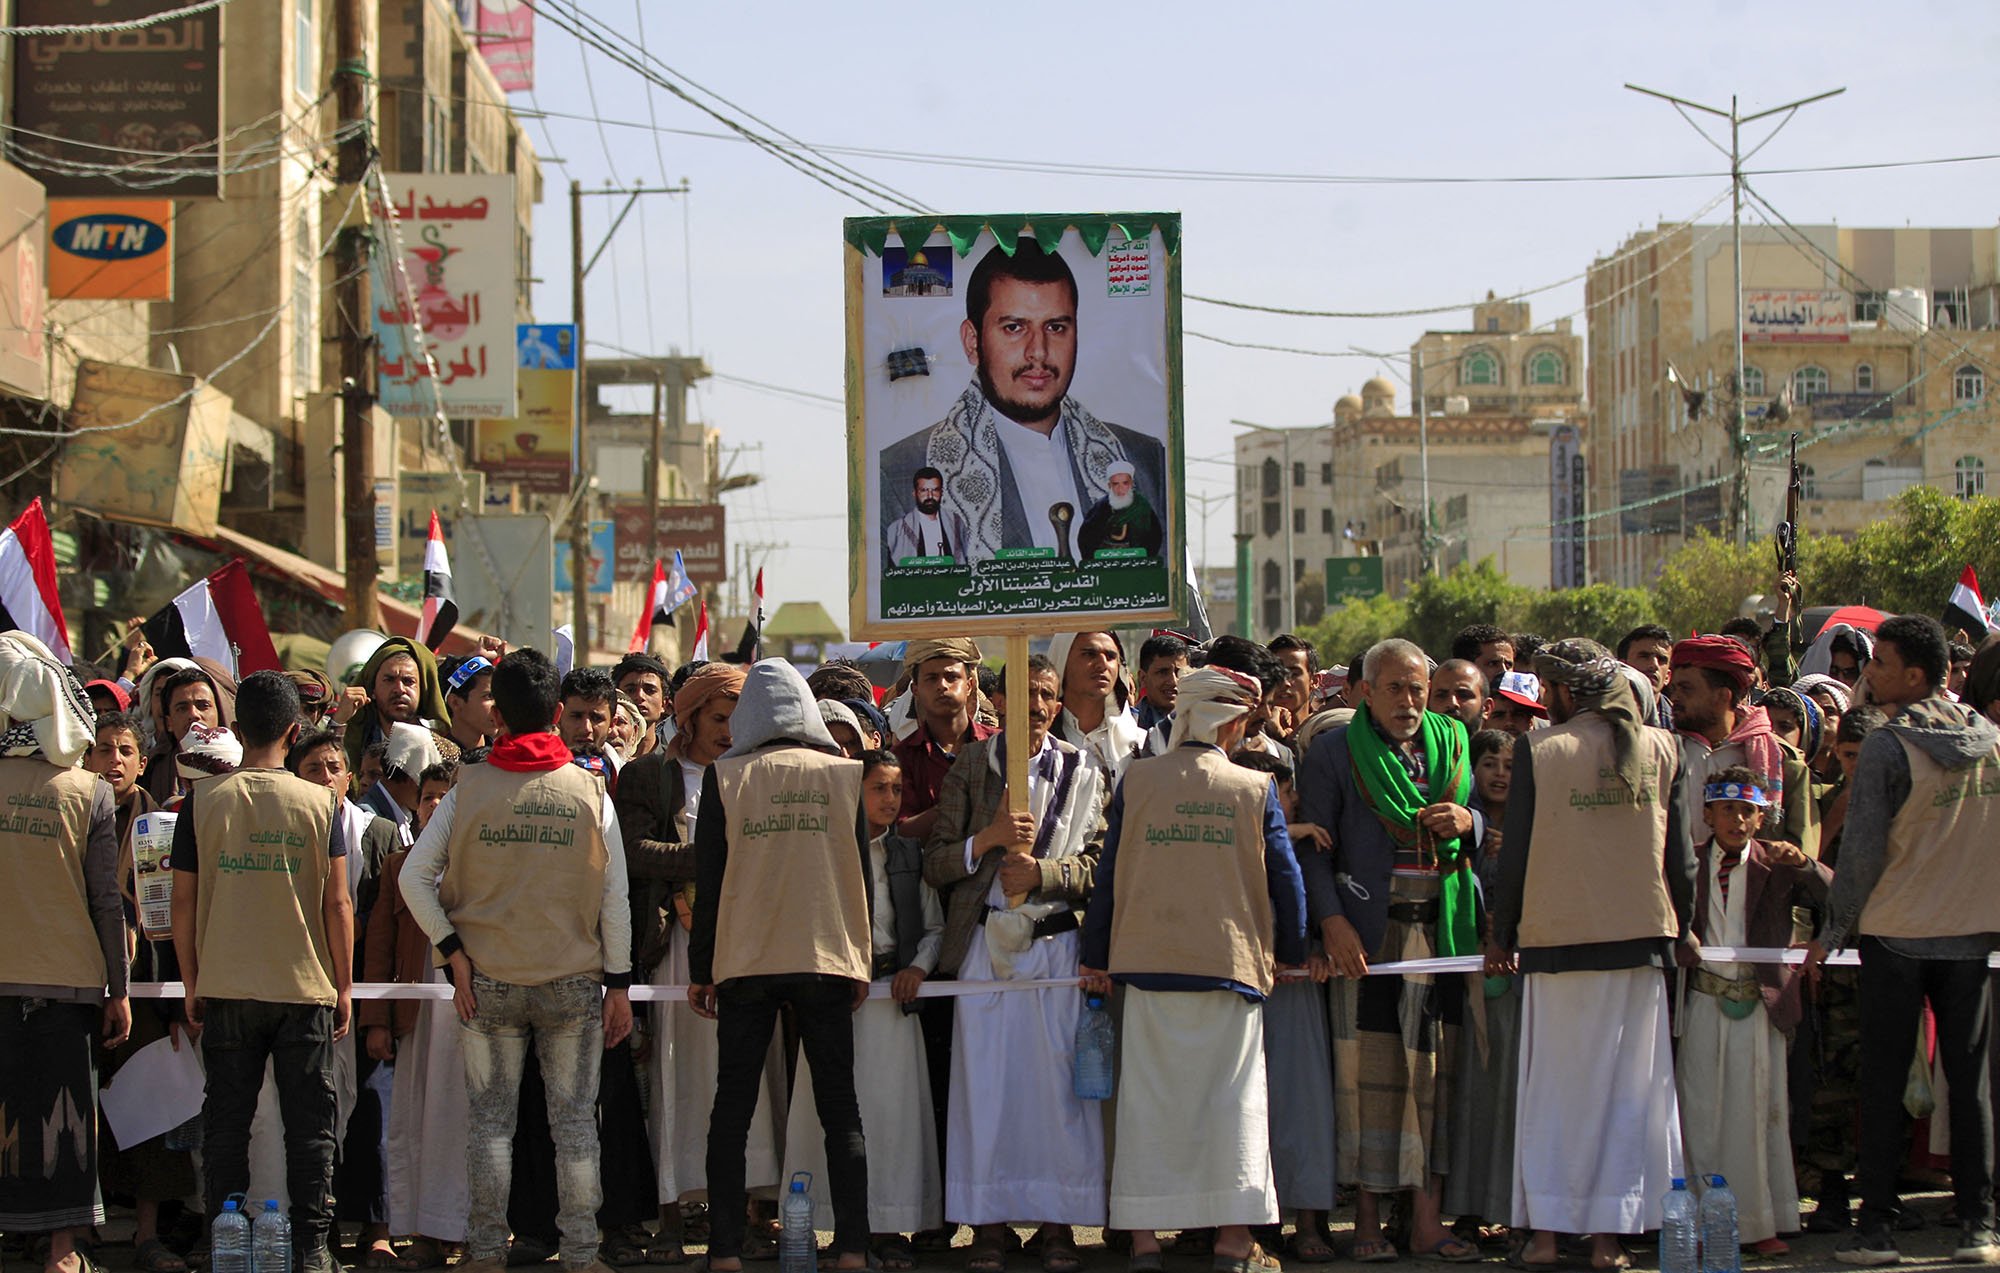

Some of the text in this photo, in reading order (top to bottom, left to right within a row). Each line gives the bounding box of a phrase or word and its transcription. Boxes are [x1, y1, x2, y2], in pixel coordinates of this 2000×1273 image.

[71, 222, 148, 251] MTN
[1133, 240, 1149, 250] الله
[1131, 254, 1149, 262] الموت
[1131, 264, 1149, 272] الموت
[379, 292, 482, 333] الجرف
[1748, 305, 1813, 333] الجلدية
[1028, 549, 1048, 557] السيد
[979, 562, 1007, 572] الحوثي
[958, 575, 1100, 597] القدس قضيتنا الأولى
[887, 591, 1166, 617] ماضون بعون الله لتحرير القدس من الصهاينة وأعوانهم
[770, 790, 830, 809] لجنة الفعاليات
[1569, 787, 1626, 811] التنظيمية
[513, 802, 577, 822] لجنة الفعاليات
[1215, 802, 1236, 822] لجنة
[28, 817, 64, 842] اللجنة
[479, 823, 575, 849] اللجنة التنظيمية
[743, 813, 828, 840] اللجنة التنظيمية
[1145, 823, 1235, 849] اللجنة التنظيمية
[286, 831, 307, 850] لجنة
[218, 847, 272, 874] التنظيمية
